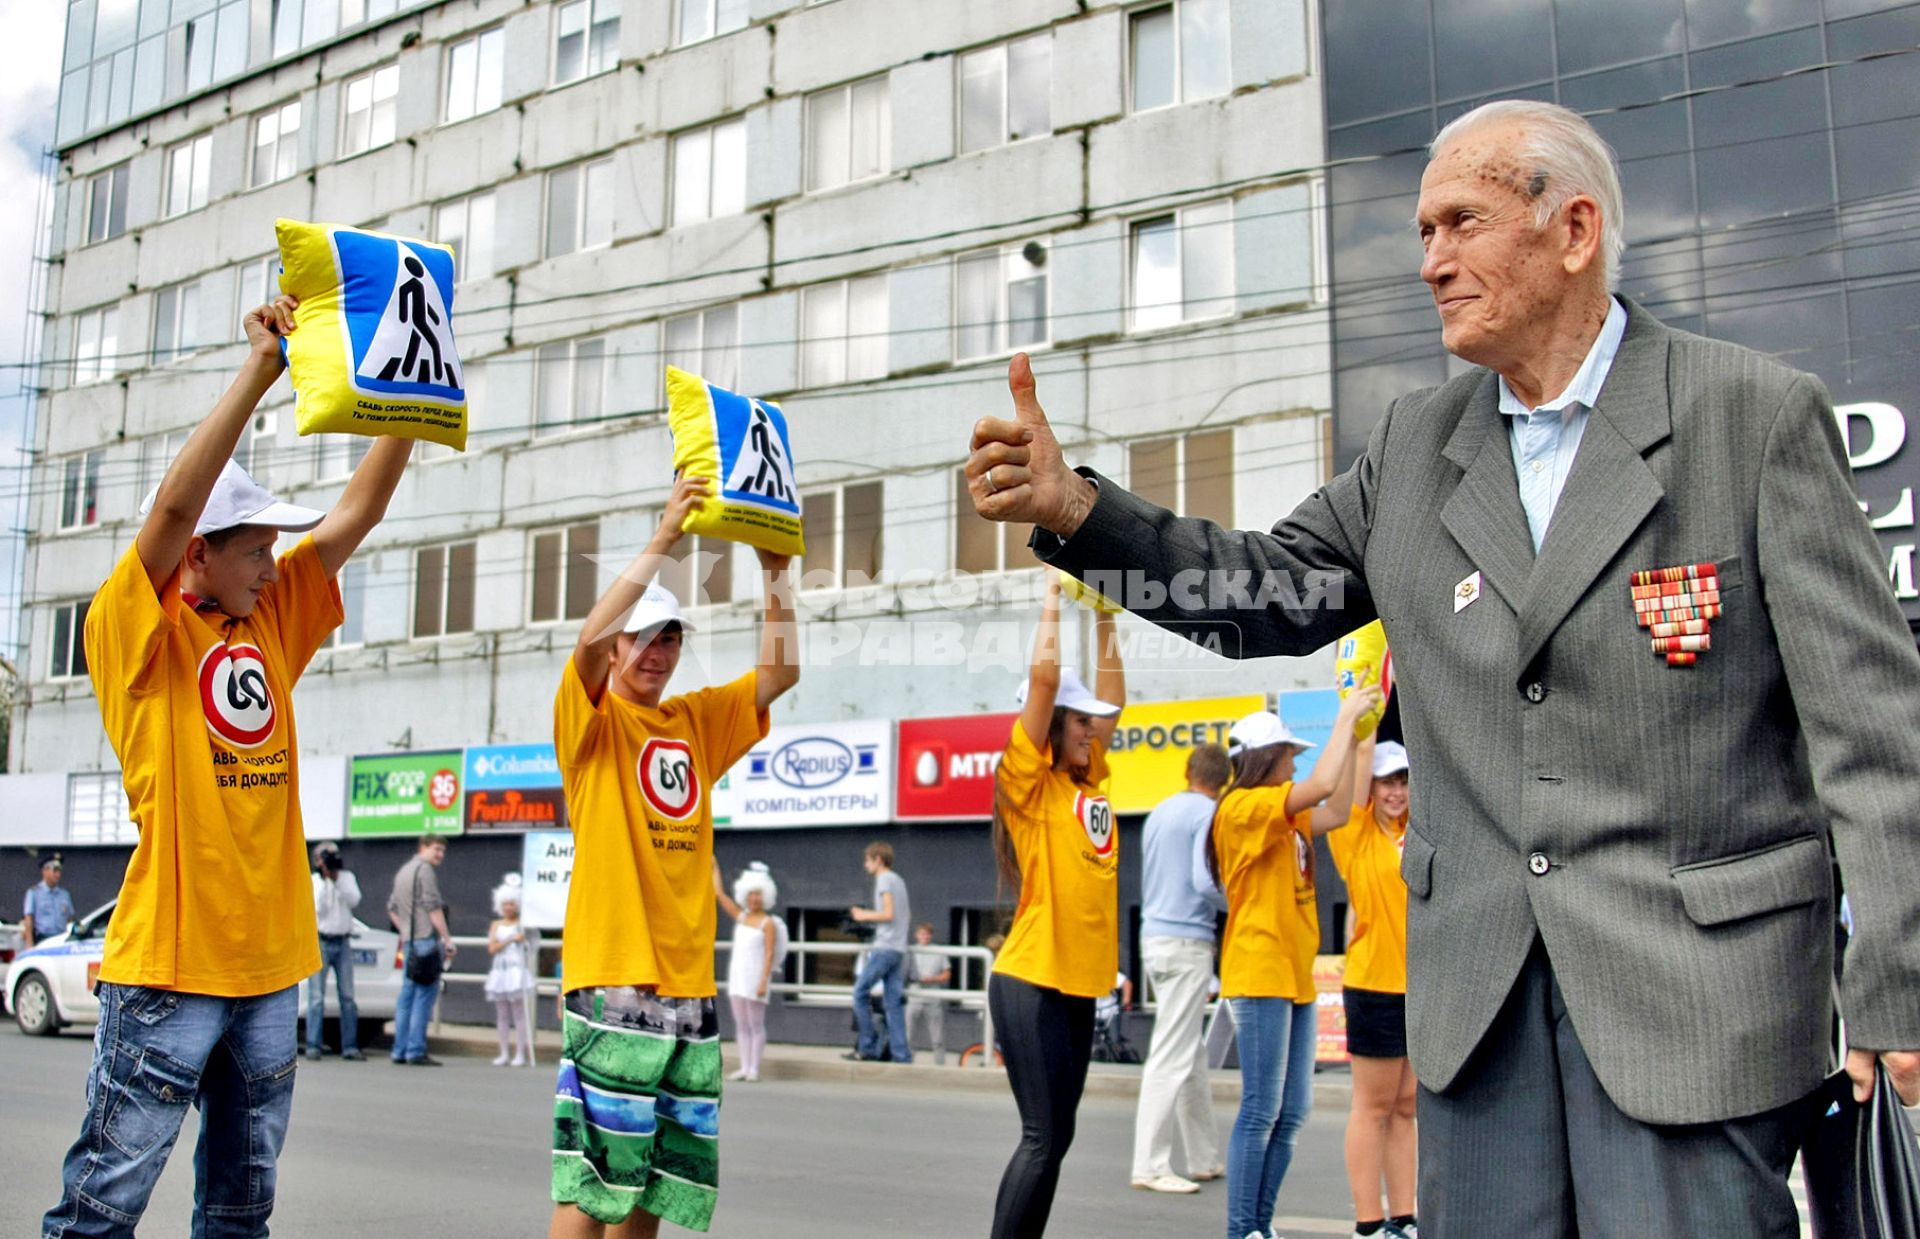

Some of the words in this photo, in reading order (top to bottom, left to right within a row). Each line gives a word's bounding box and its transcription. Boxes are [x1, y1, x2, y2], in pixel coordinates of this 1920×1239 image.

[1110, 720, 1236, 751] ВРОСЕТ
[213, 751, 238, 765] АВЬ
[431, 774, 456, 798] 36
[744, 793, 879, 814] КОМПЬЮТЕРЫ
[648, 820, 667, 832] АВЬ
[1090, 803, 1109, 835] 60
[536, 870, 557, 883] не
